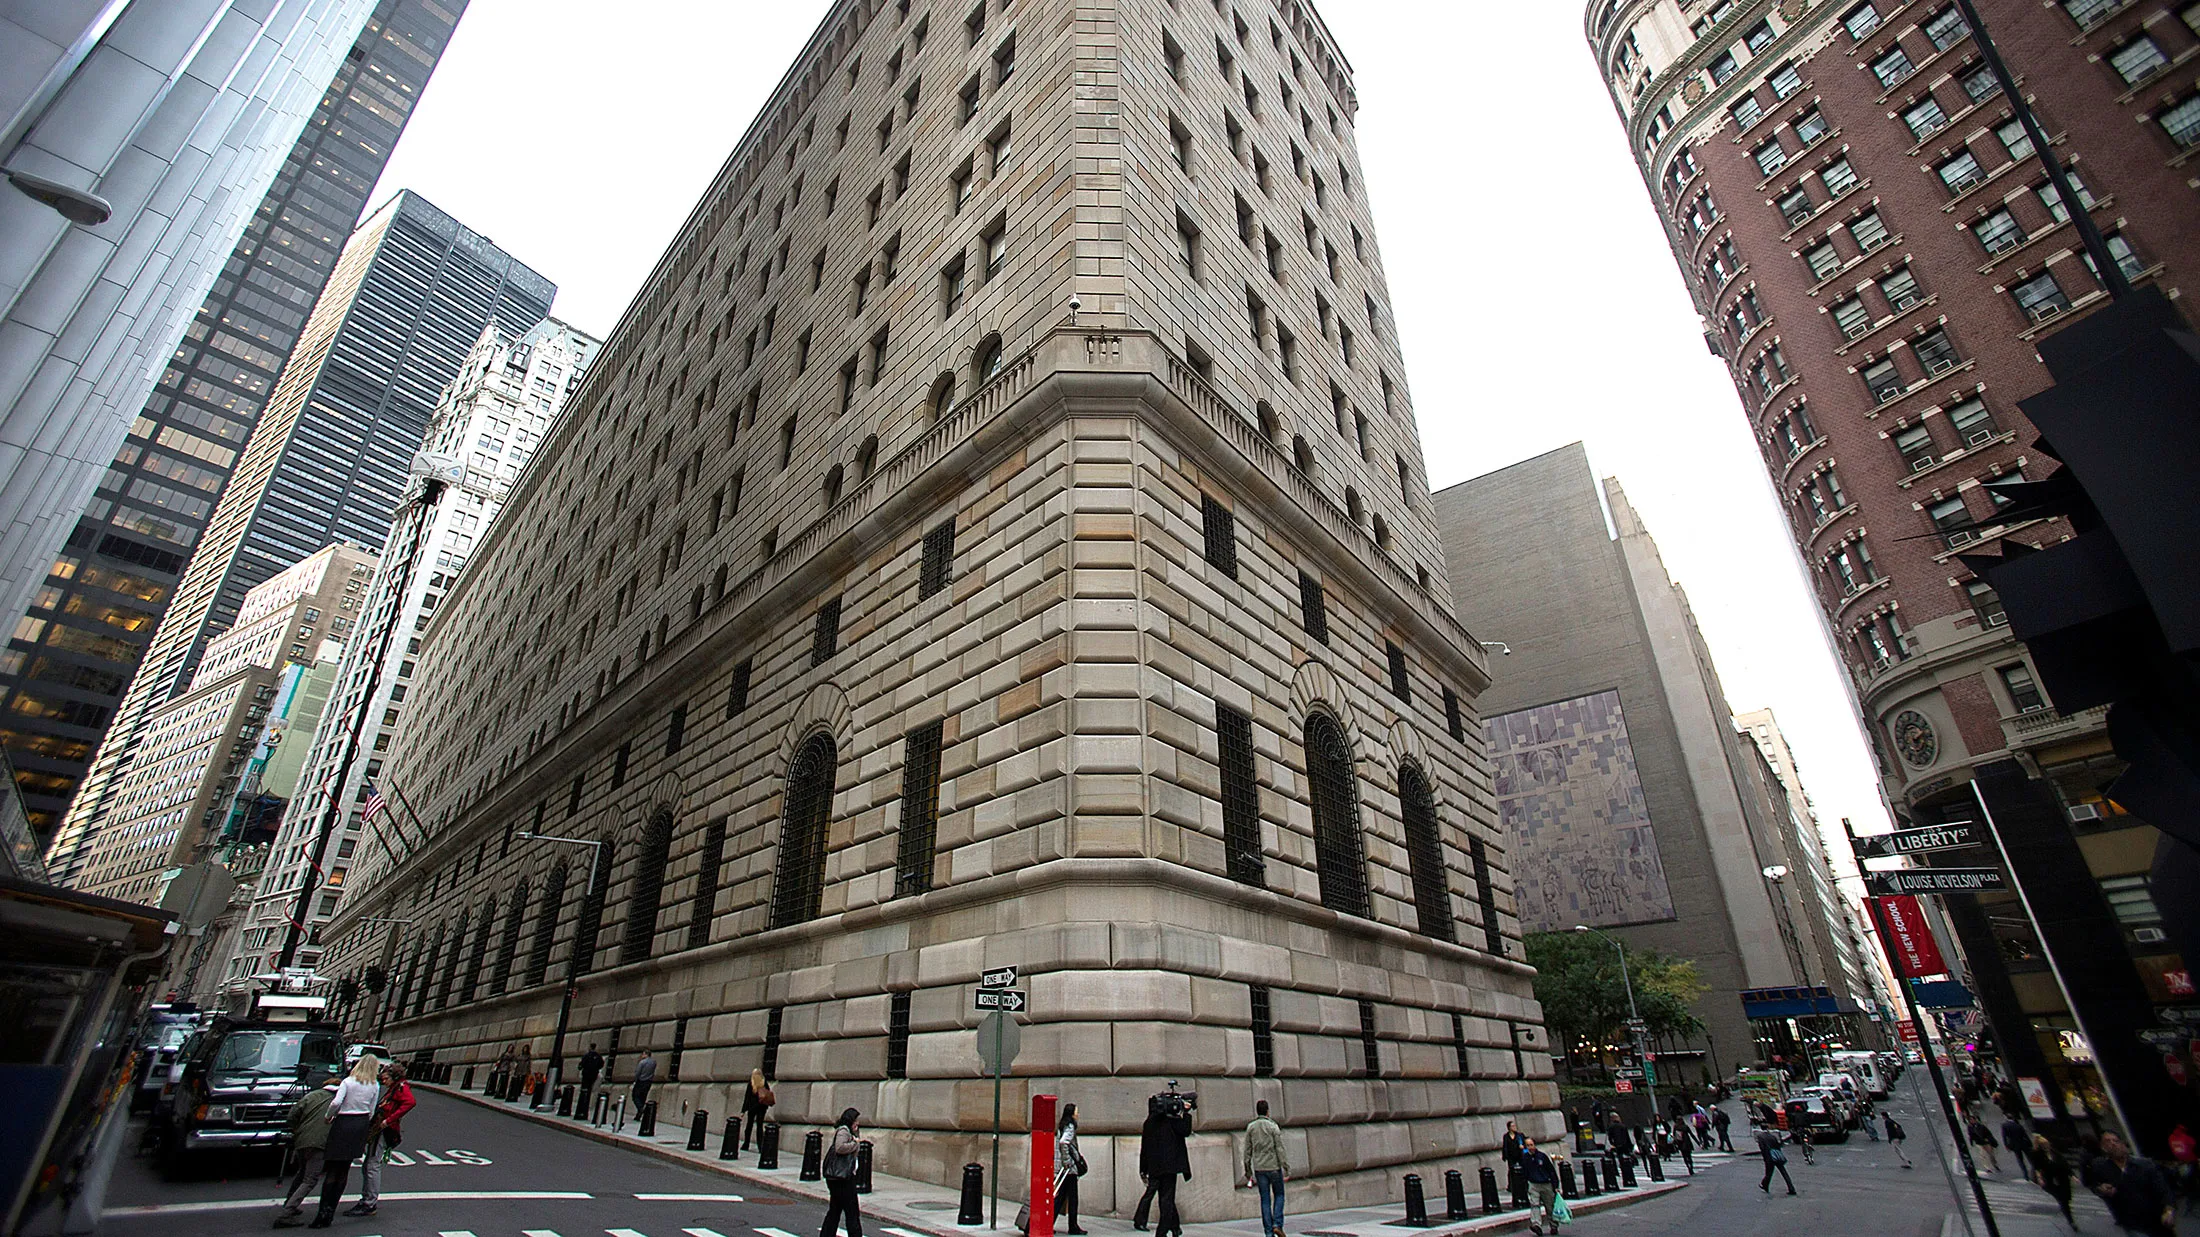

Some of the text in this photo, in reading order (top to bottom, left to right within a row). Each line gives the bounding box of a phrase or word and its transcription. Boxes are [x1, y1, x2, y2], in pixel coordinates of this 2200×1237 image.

[1896, 829, 1969, 851] LIBERTY ST
[1900, 874, 2000, 889] LOUISE NEVELSON PLAZA
[1887, 901, 1907, 932] SCHOOL
[1900, 933, 1915, 952] NEW
[1908, 953, 1922, 969] THE
[986, 973, 1012, 984] ONE WAY
[982, 996, 1018, 1006] ONE WAY
